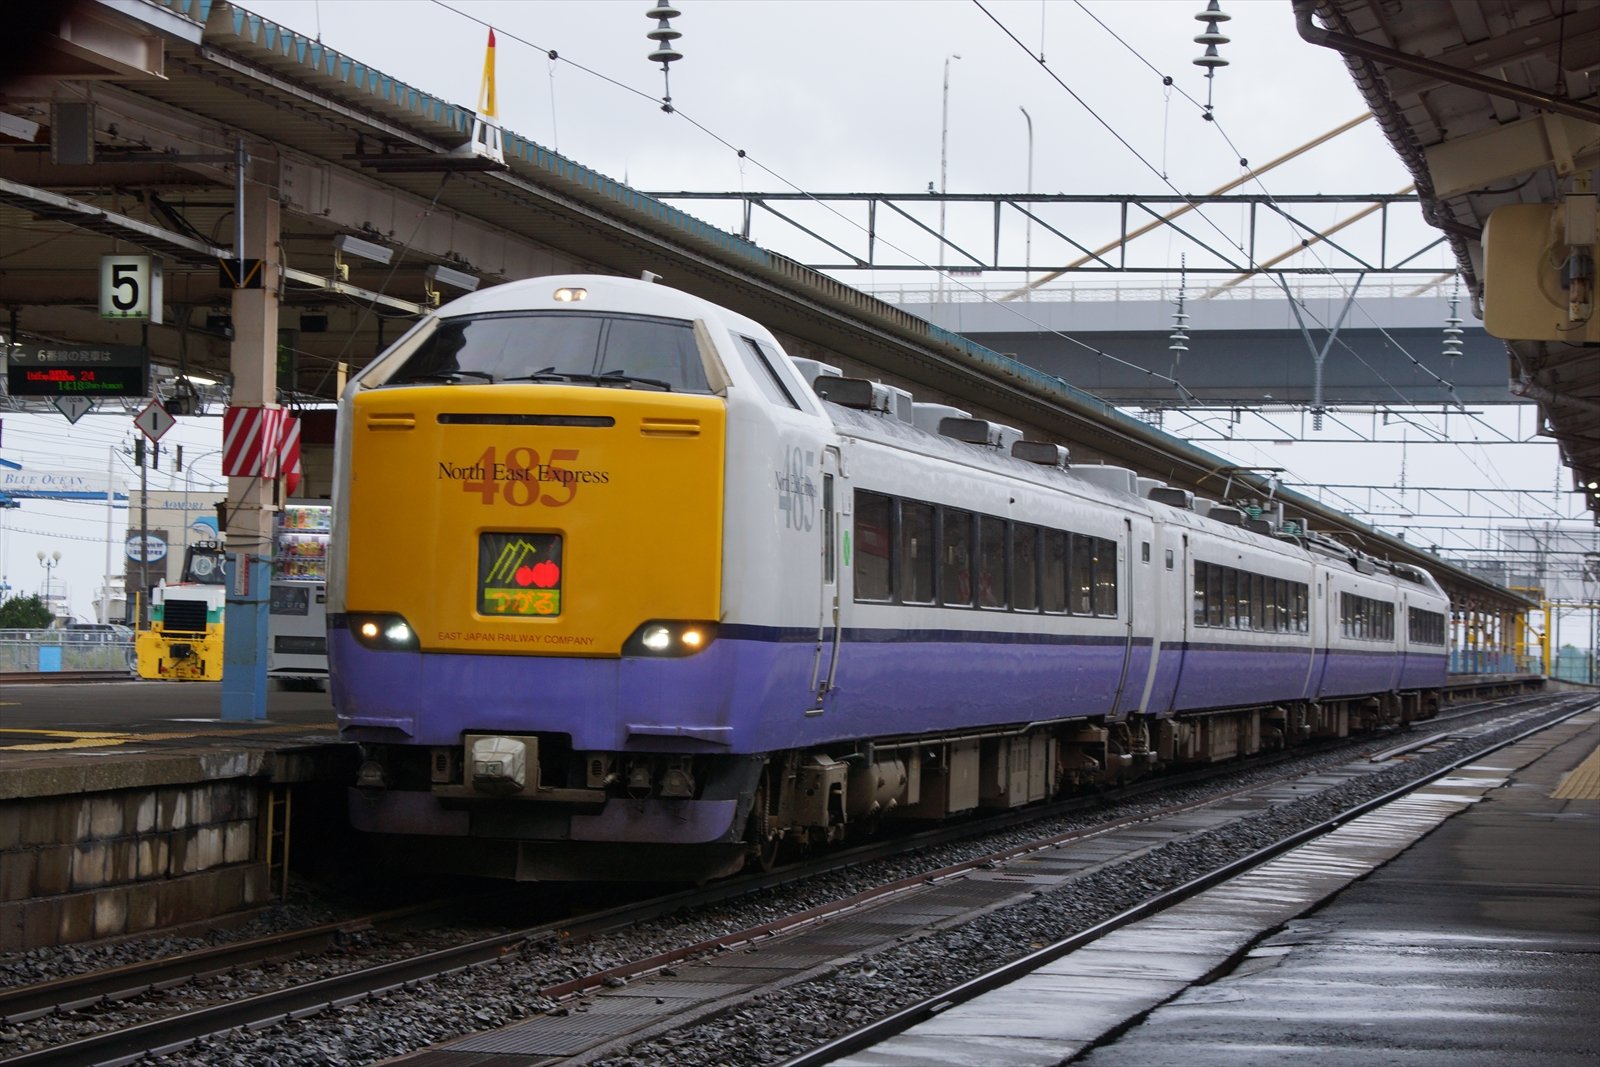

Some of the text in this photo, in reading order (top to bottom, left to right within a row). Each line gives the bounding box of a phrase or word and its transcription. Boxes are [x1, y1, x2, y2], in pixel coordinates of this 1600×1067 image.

[112, 264, 139, 310] 5
[438, 462, 609, 487] North East Express
[463, 446, 580, 507] 485
[162, 500, 204, 510] AOMORI
[493, 592, 554, 614] つがる
[438, 632, 594, 645] EAST JAPAN RAILWAY COMPANY
